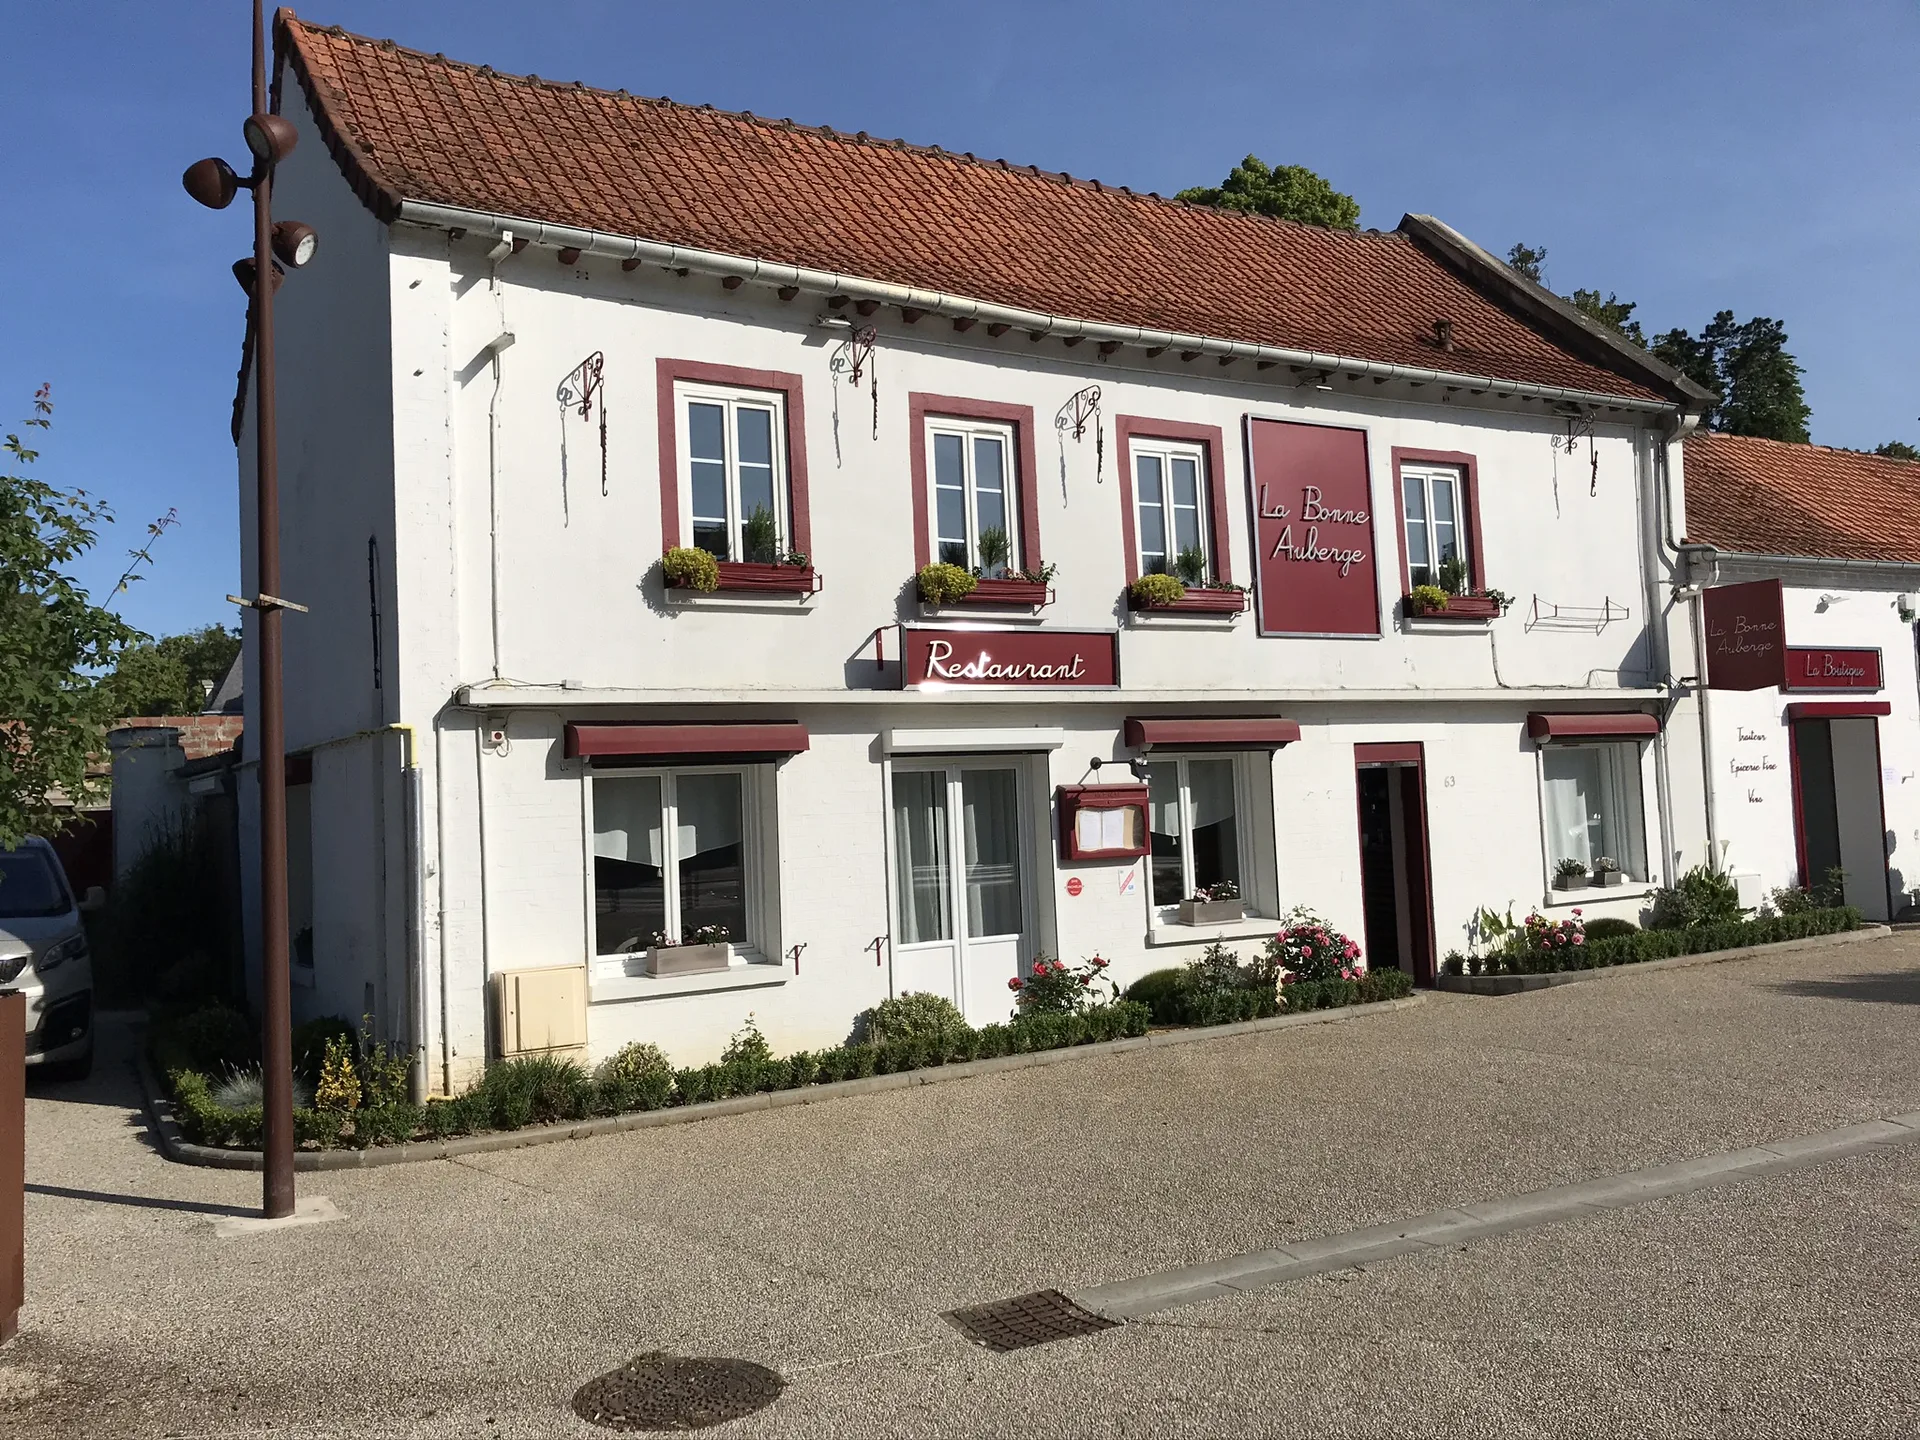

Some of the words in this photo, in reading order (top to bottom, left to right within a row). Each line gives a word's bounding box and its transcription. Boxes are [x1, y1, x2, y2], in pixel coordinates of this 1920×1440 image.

[1263, 482, 1290, 518] La
[1303, 485, 1370, 524] Bonne
[1273, 525, 1366, 576] Auberge
[1711, 620, 1726, 636] La
[1735, 616, 1777, 634] Bonne
[927, 640, 1086, 678] Restaurant
[1716, 637, 1774, 657] Auberge
[1806, 654, 1820, 676] La
[1824, 654, 1865, 685] Boutique
[1444, 775, 1456, 788] 63
